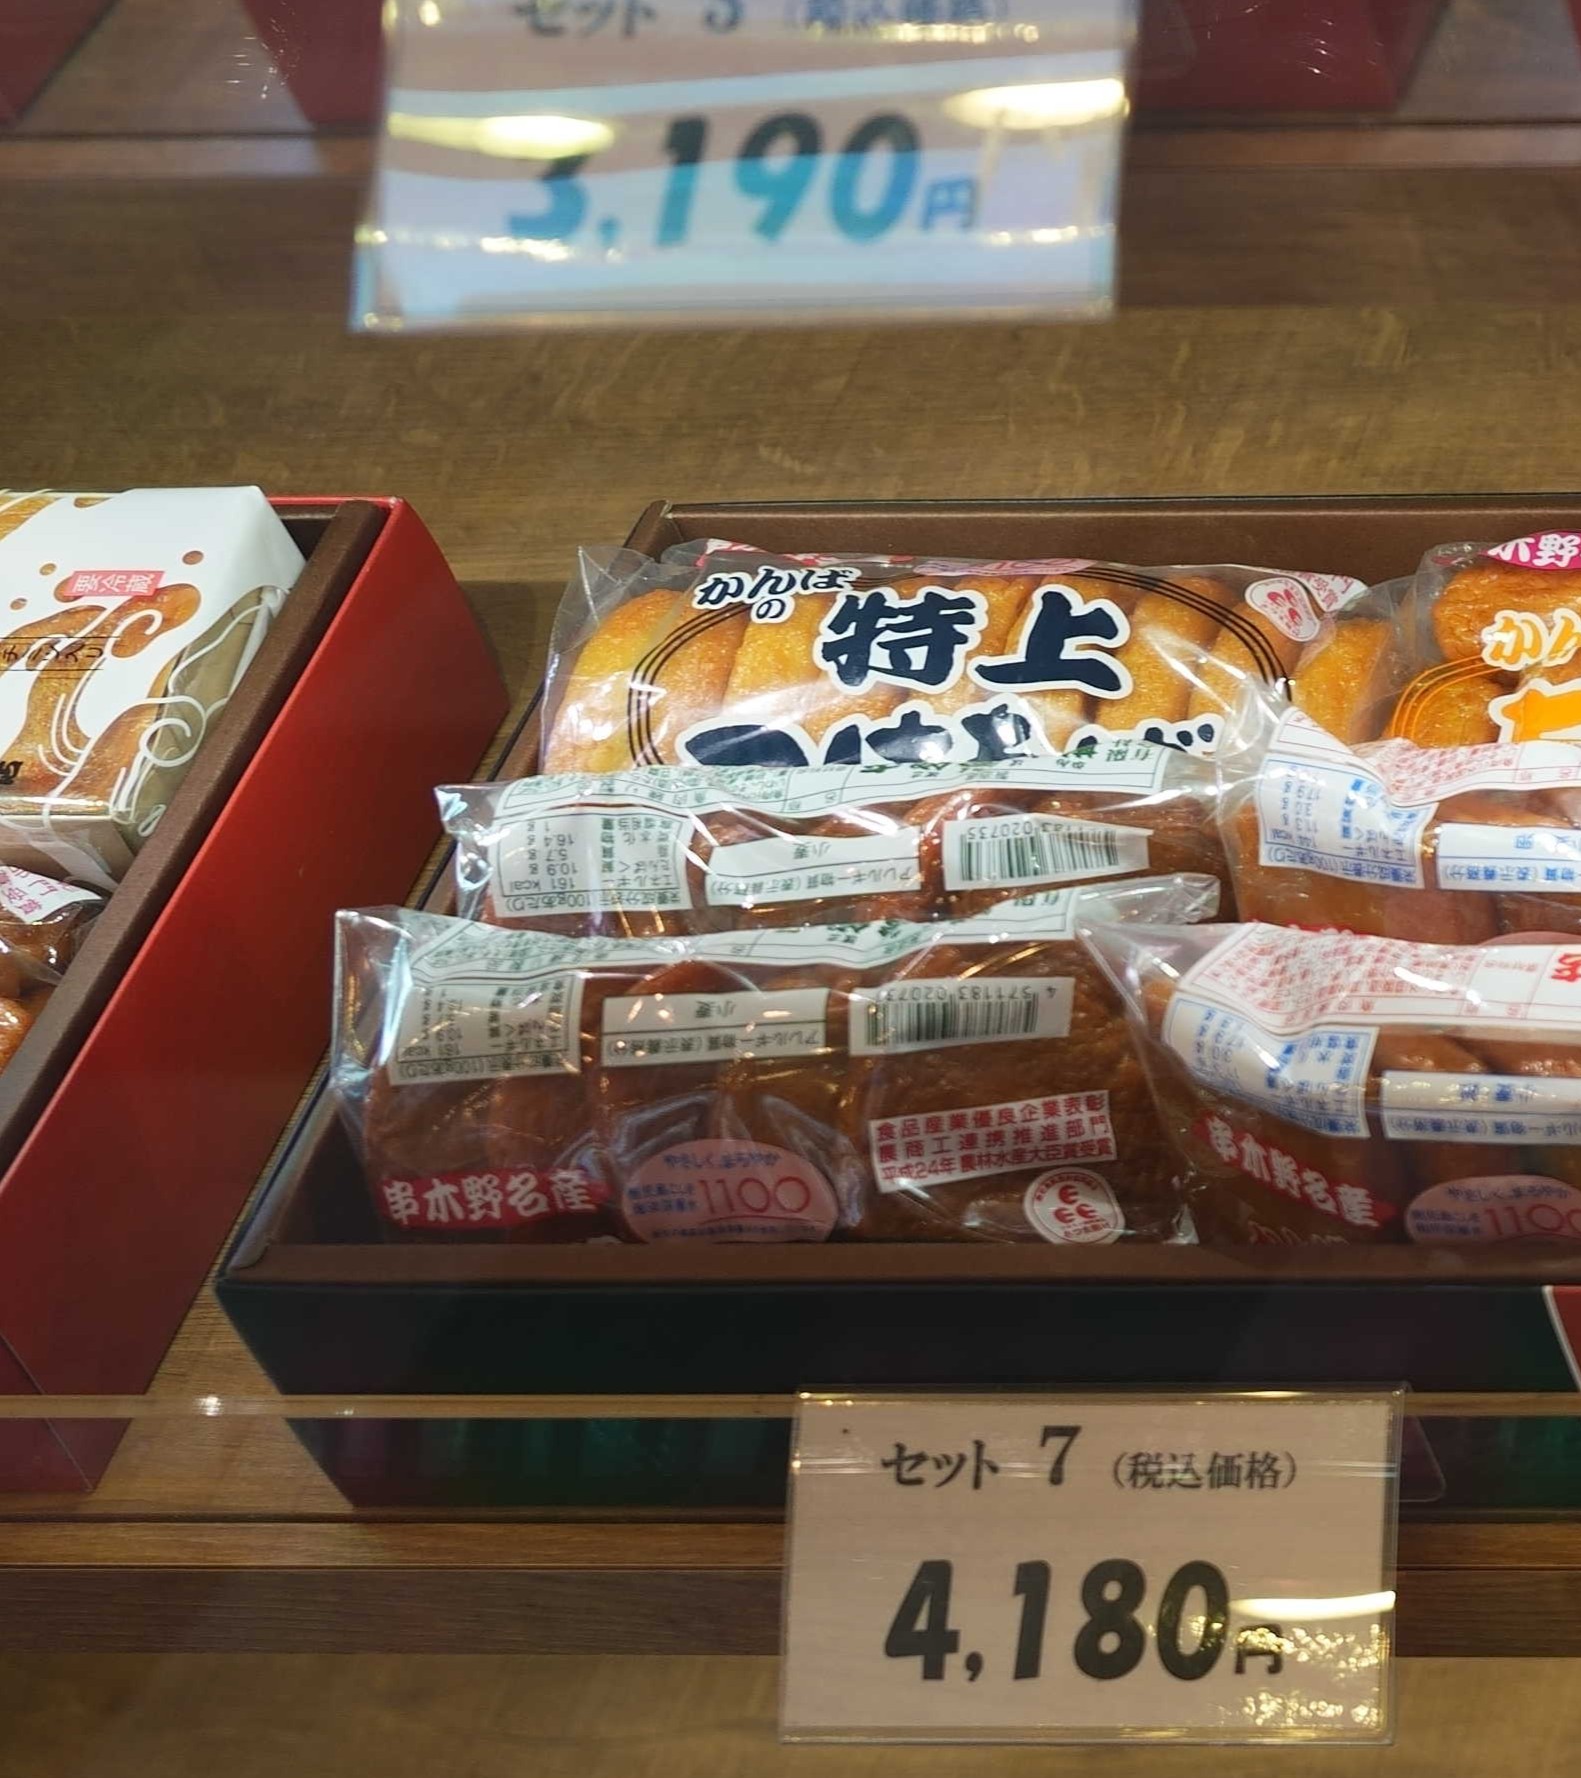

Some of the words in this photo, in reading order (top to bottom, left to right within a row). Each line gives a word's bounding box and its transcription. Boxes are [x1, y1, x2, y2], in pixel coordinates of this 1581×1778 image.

[820, 588, 1126, 692] 特上
[702, 1175, 812, 1215] 1100
[883, 1440, 1000, 1490] セット
[1040, 1425, 1083, 1487] 7
[1112, 1451, 1298, 1491] (税込価格)
[885, 1558, 1285, 1682] 4,180円
